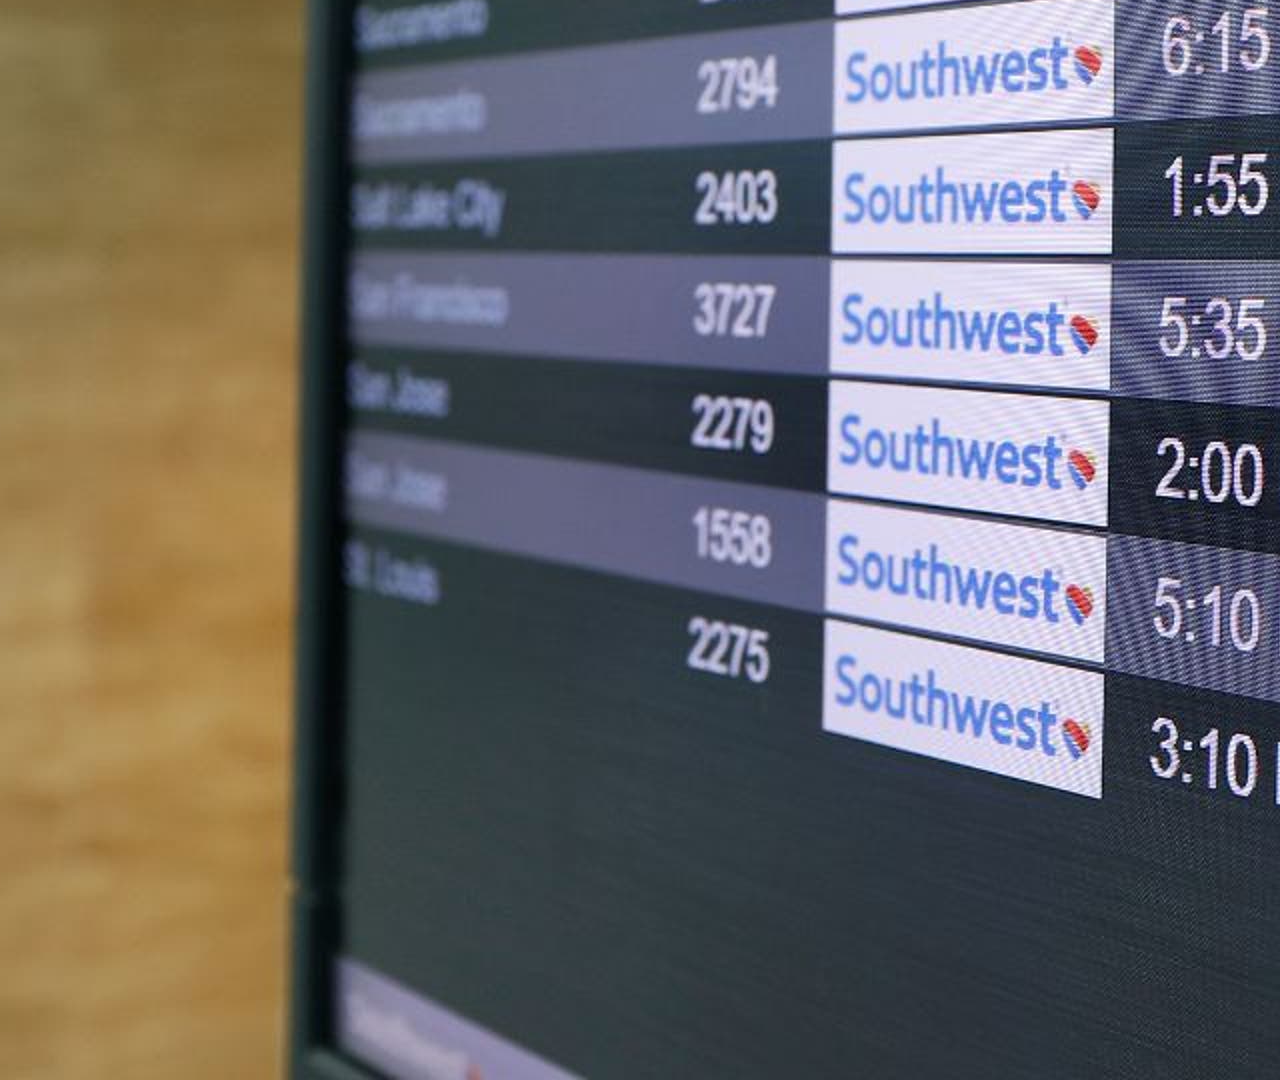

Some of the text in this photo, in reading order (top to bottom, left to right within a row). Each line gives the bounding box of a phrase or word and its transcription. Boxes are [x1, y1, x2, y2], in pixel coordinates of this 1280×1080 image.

[697, 54, 779, 114] 2794
[845, 36, 1068, 103] Southwest
[1162, 8, 1271, 77] 6:15
[693, 168, 779, 226] 2403
[843, 166, 1067, 223] Southwest
[1164, 153, 1269, 218] 1:55
[693, 282, 777, 338] 3727
[841, 291, 1065, 357] Southwest
[1158, 296, 1266, 362] 5:35
[690, 393, 776, 454] 2279
[839, 414, 1062, 490] Southwest
[1155, 436, 1264, 508] 2:00
[692, 507, 772, 569] 1558
[837, 534, 1060, 625] Southwest
[1154, 577, 1261, 653] 5:10
[686, 615, 771, 684] 2275
[834, 654, 1057, 758] Southwest
[1150, 717, 1258, 798] 3:10
